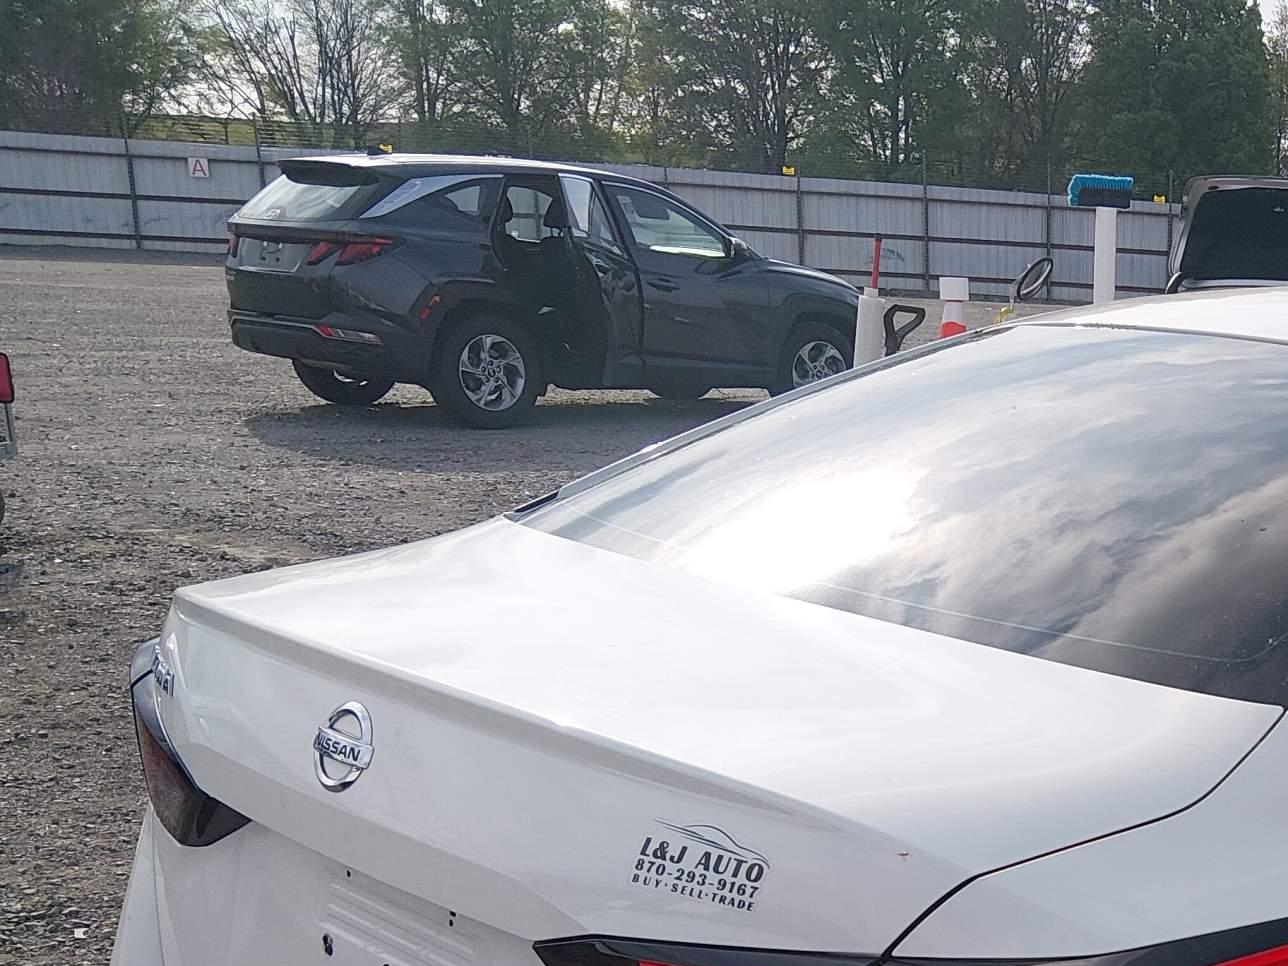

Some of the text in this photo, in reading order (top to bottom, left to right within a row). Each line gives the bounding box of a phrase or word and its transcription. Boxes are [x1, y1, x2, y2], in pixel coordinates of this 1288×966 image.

[192, 159, 207, 176] A
[316, 732, 361, 762] NISSAN
[640, 837, 765, 883] L&J AUTO
[634, 858, 760, 899] 870-293-9167
